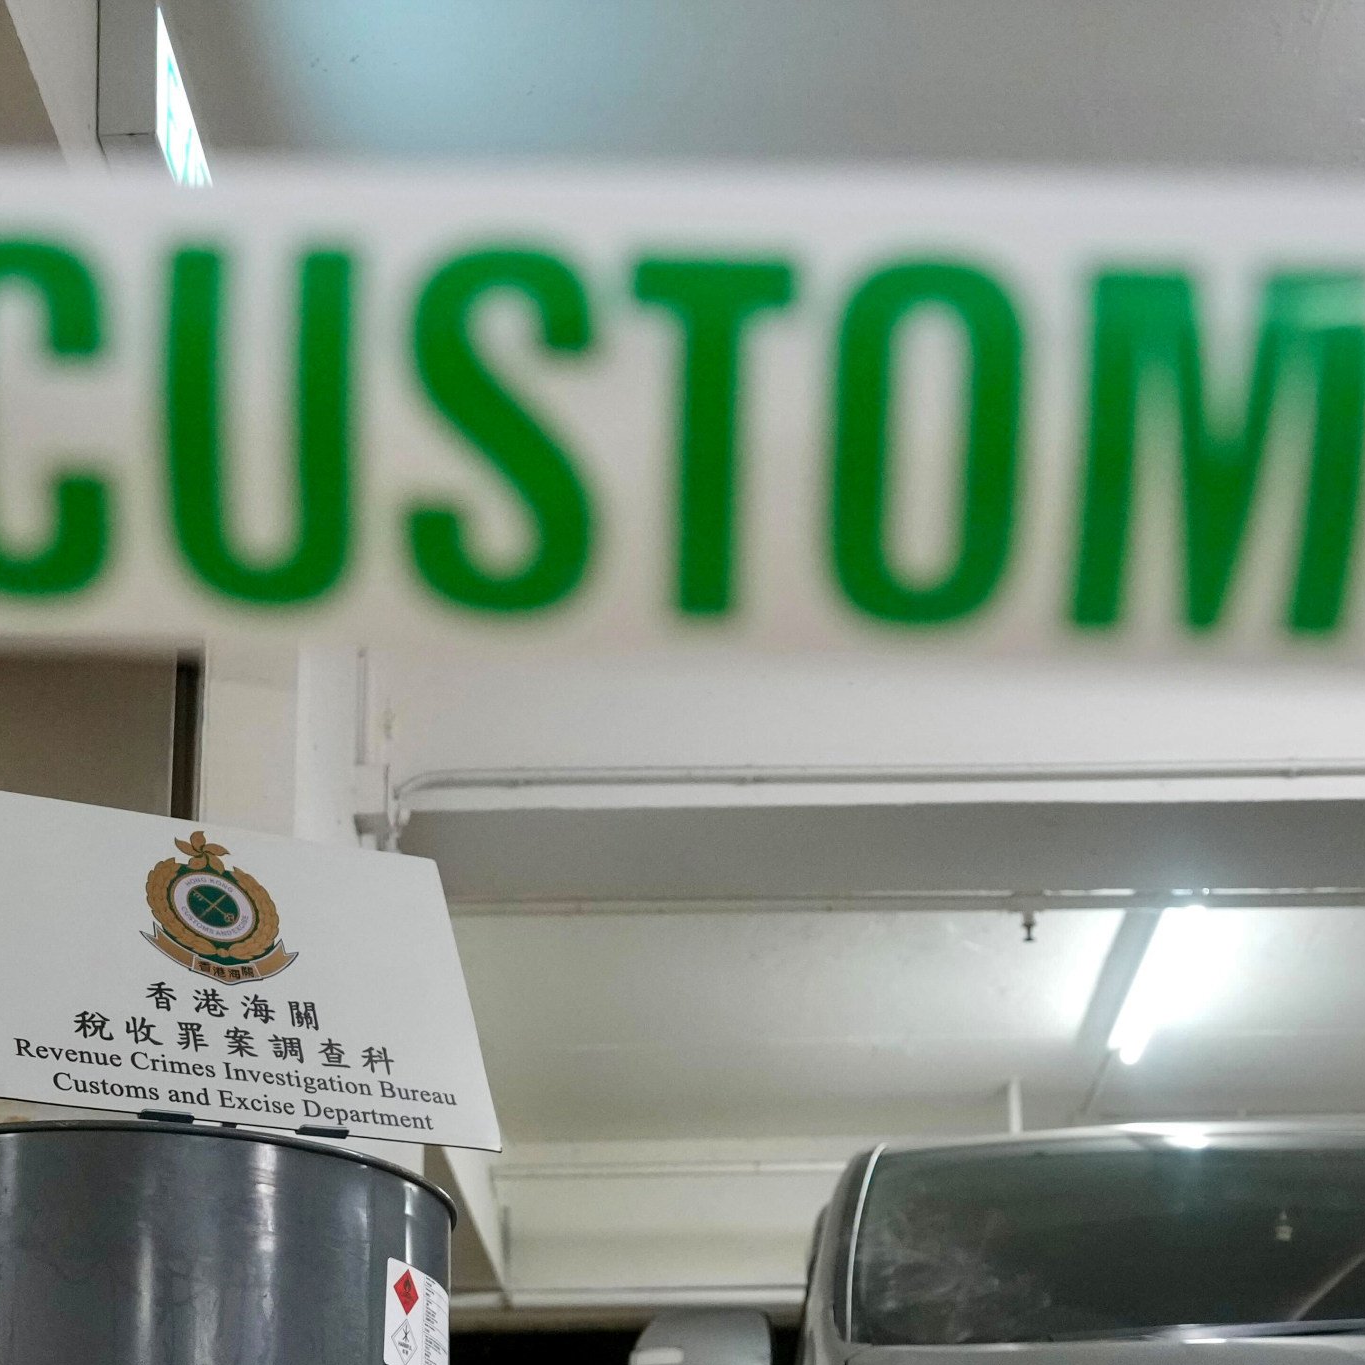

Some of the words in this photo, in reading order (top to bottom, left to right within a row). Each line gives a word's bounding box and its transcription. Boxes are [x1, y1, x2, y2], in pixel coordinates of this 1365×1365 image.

[198, 961, 255, 979] 香港海關
[145, 981, 319, 1031] 香港海關
[13, 1037, 122, 1068] Revenue
[130, 1050, 216, 1079] Crimes
[223, 1061, 372, 1096] Investigation
[380, 1079, 458, 1107] Bureau
[73, 1010, 395, 1075] 稅收罪案調查科
[52, 1071, 160, 1102] Customs
[168, 1086, 211, 1107] and
[218, 1091, 295, 1116] Excise
[302, 1098, 435, 1131] Department
